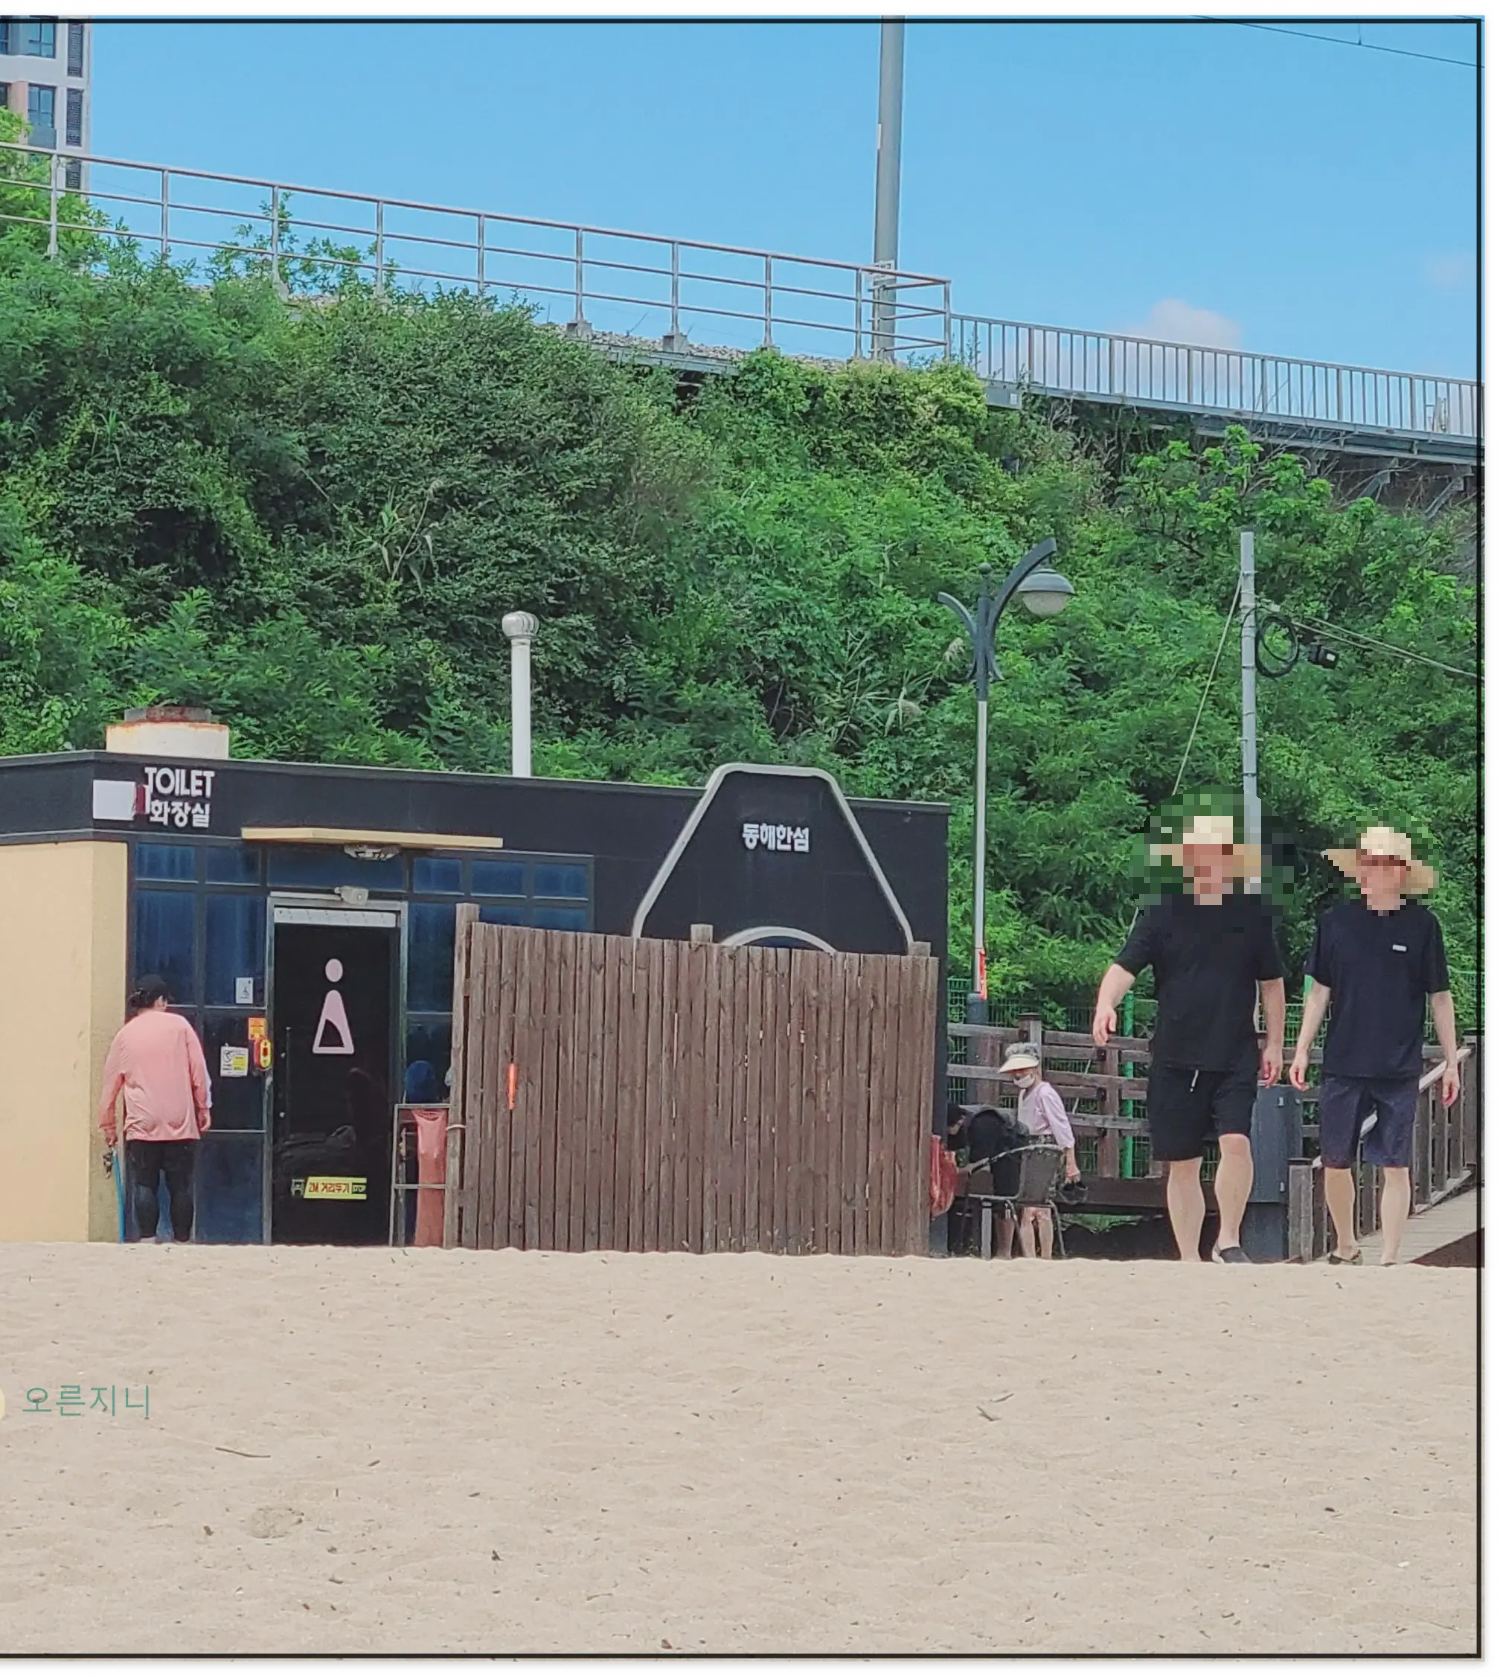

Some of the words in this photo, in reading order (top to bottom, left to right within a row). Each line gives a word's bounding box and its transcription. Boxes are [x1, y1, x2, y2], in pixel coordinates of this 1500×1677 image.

[144, 767, 215, 798] TOILET
[150, 799, 210, 828] 화장실
[742, 823, 810, 852] 동해한섬
